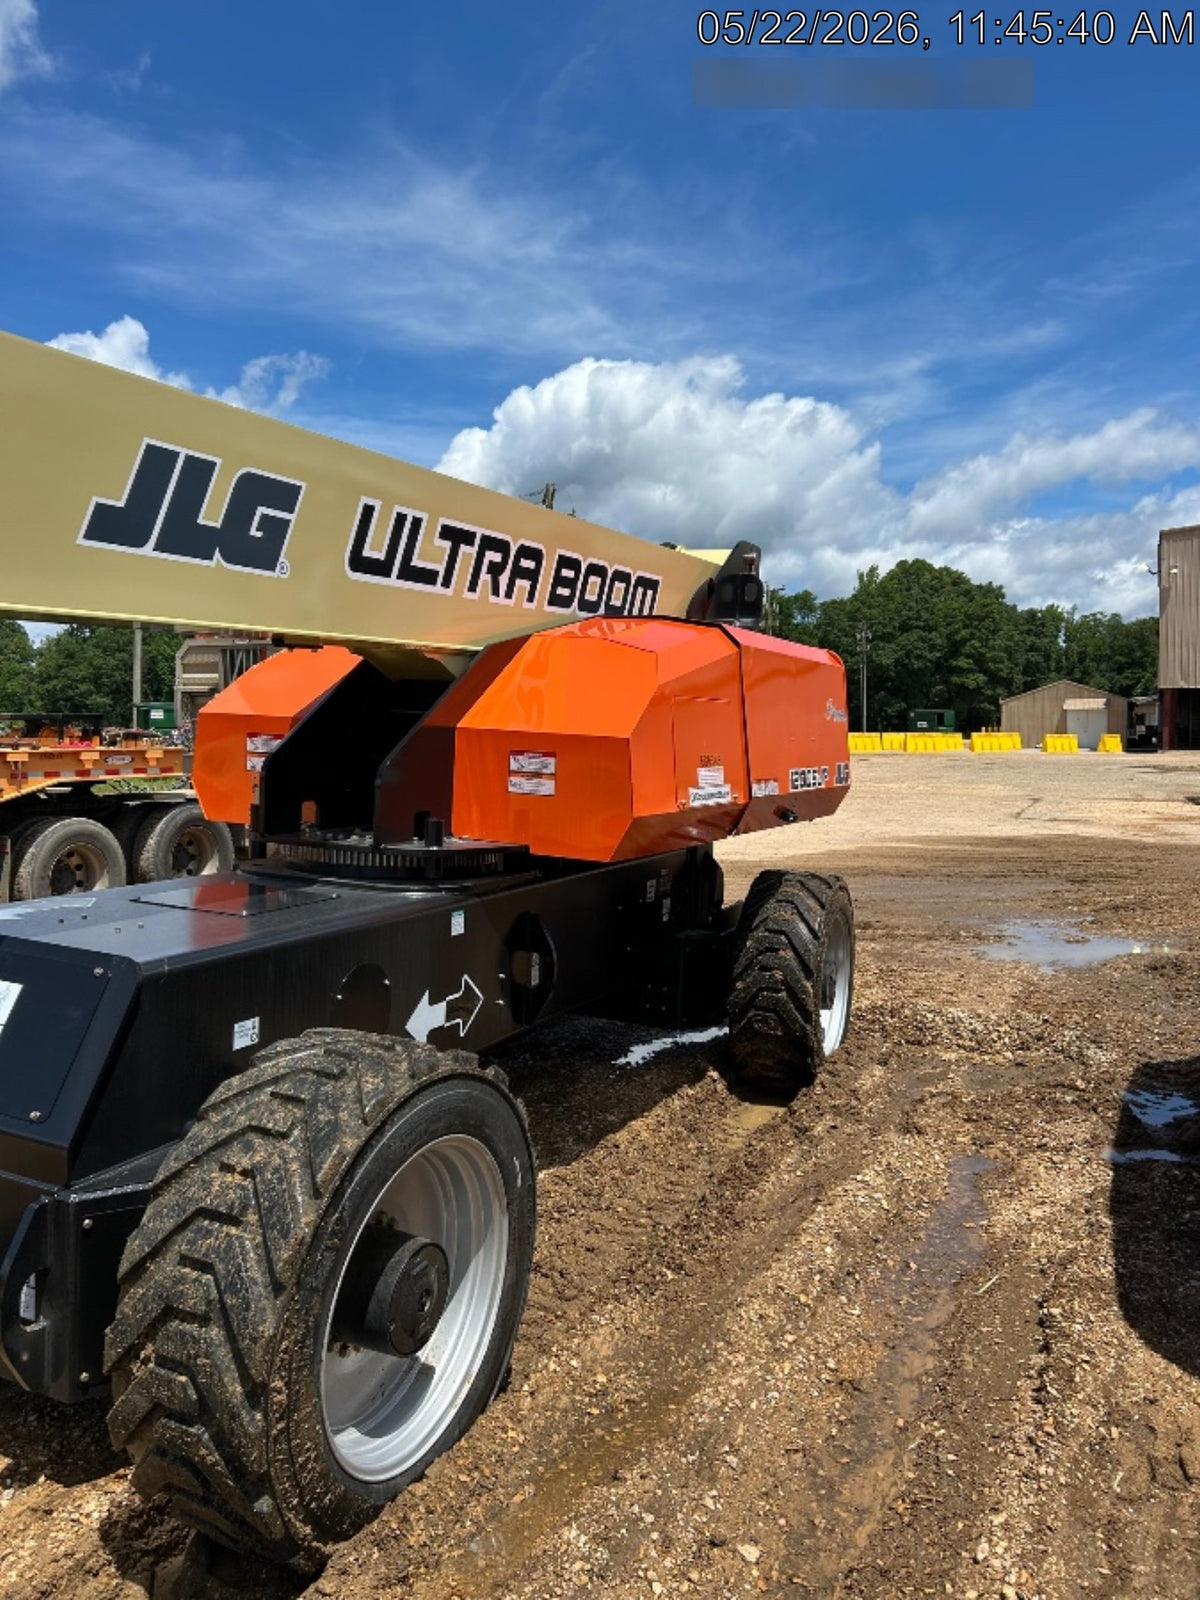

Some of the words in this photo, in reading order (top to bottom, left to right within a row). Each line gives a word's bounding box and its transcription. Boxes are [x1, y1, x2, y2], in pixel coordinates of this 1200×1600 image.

[77, 438, 306, 576] JLG
[346, 498, 544, 607] ULTRA
[545, 551, 661, 616] BOOM
